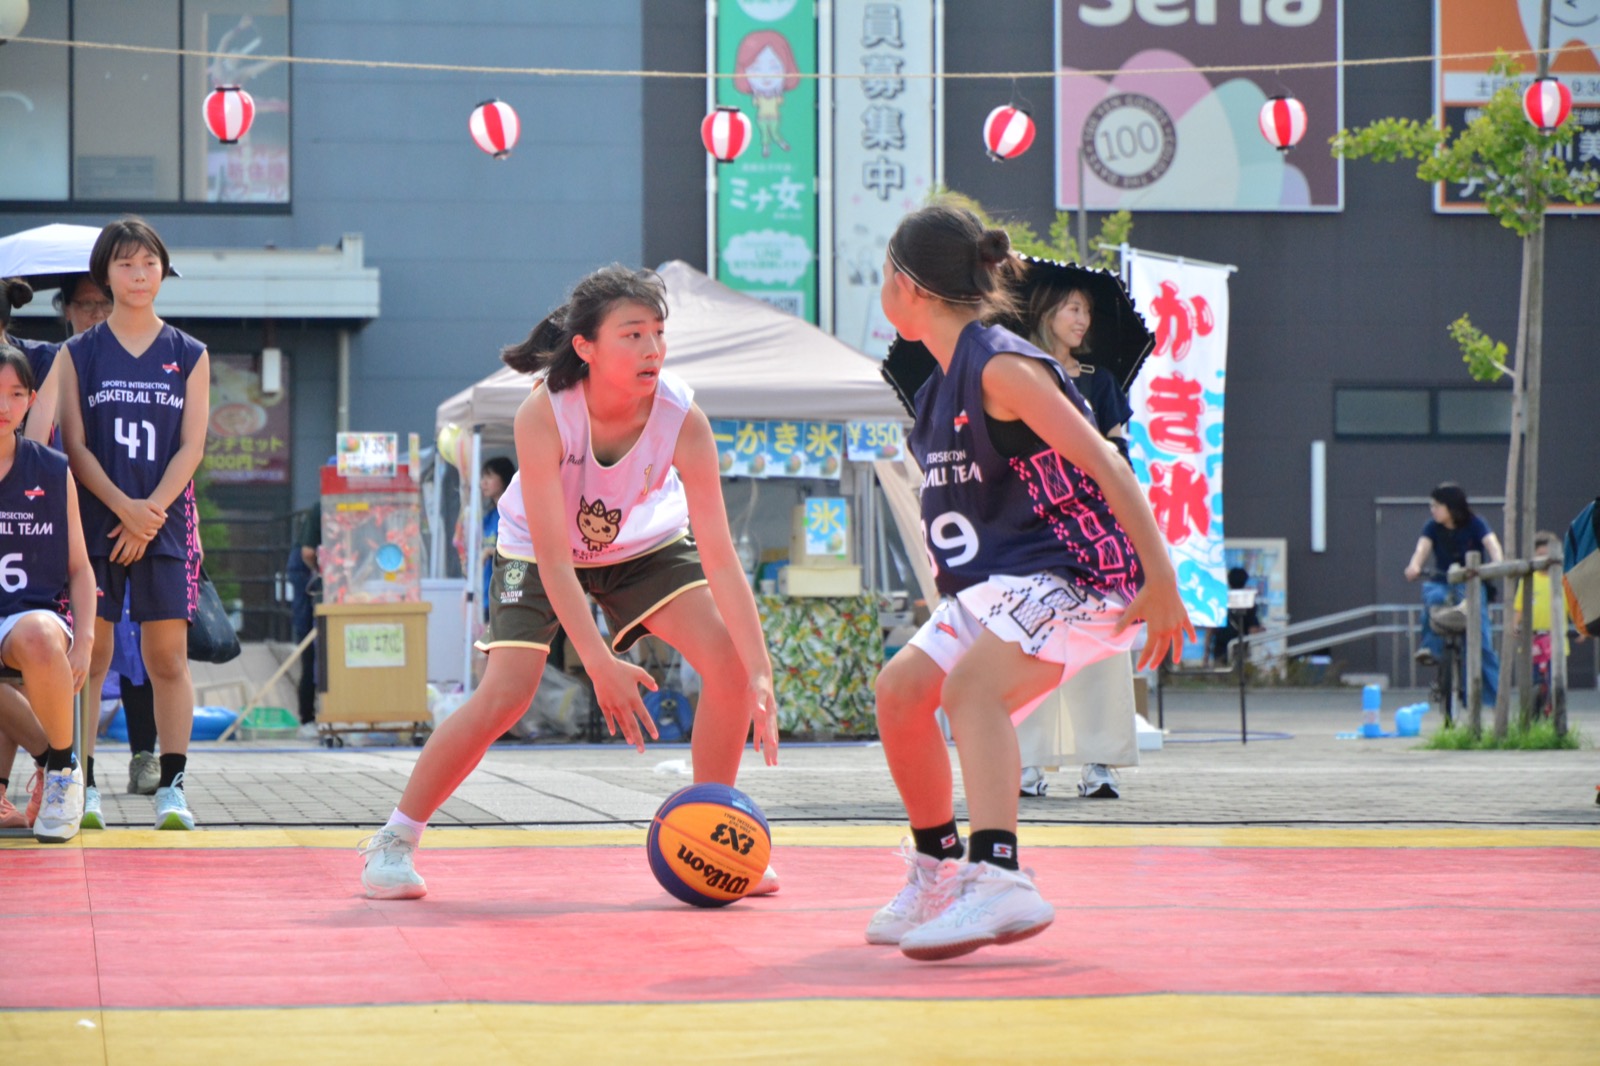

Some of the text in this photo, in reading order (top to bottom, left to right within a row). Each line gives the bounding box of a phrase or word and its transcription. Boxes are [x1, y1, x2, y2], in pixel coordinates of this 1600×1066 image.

[1100, 120, 1160, 161] 100
[88, 389, 184, 410] BASKETBALL TEAM
[101, 380, 171, 391] SPORTS INTERSECTION
[1146, 280, 1215, 546] かき氷
[114, 417, 156, 461] 41
[849, 423, 900, 447] ¥350
[18, 522, 53, 536] TEAM
[811, 501, 841, 534] 氷
[676, 843, 751, 895] Wilson
